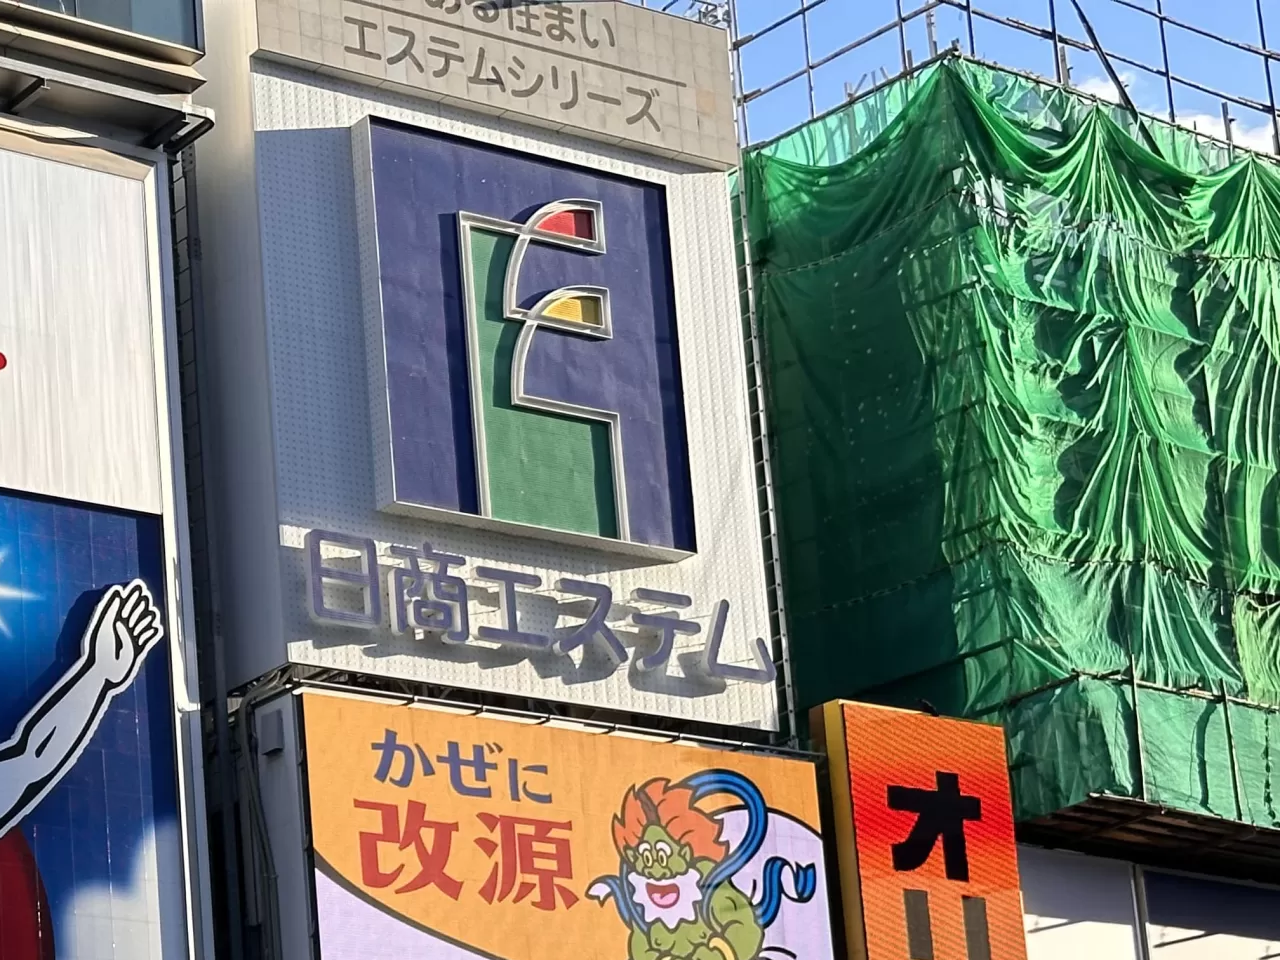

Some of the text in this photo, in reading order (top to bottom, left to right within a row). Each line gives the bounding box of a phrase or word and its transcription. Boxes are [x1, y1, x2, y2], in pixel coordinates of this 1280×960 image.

[343, 15, 662, 132] エステムシリーズ
[304, 528, 778, 682] 日商エステム
[370, 728, 553, 804] かぜに
[353, 798, 580, 912] 改源
